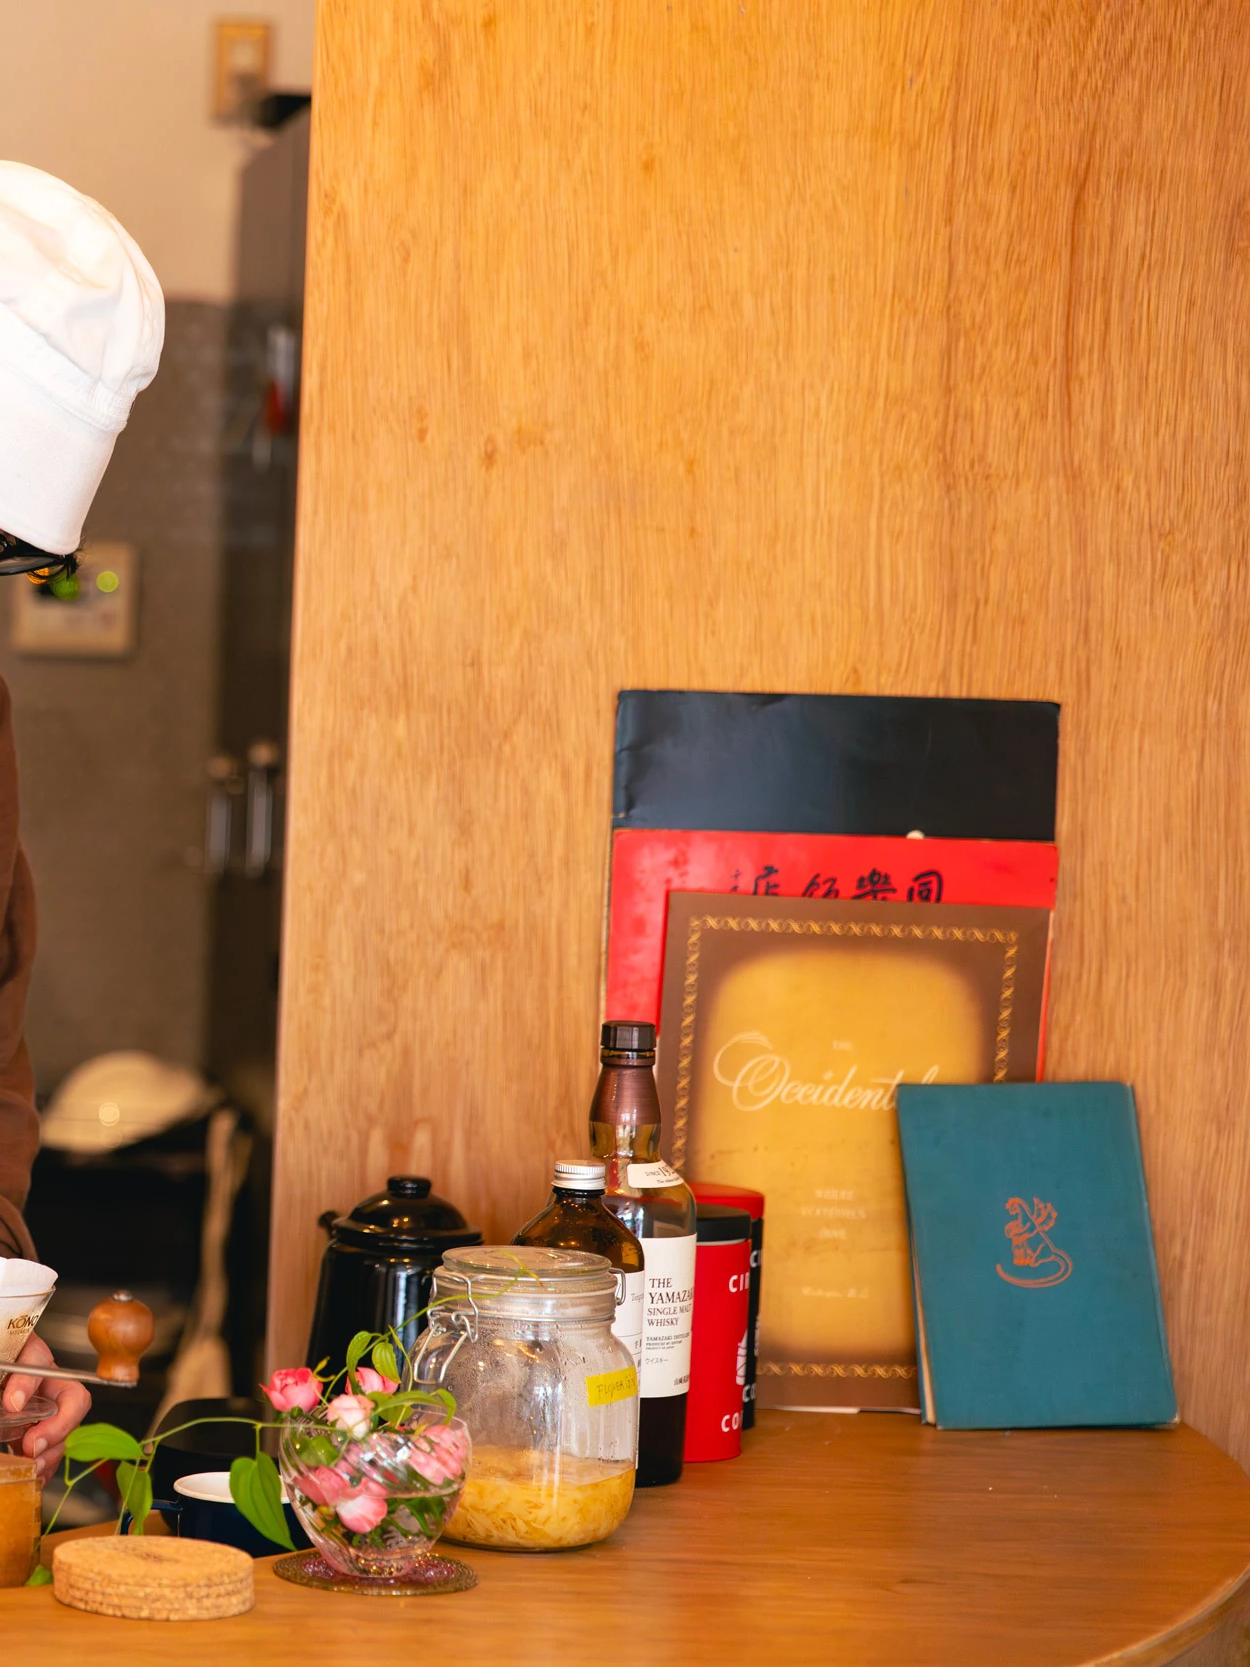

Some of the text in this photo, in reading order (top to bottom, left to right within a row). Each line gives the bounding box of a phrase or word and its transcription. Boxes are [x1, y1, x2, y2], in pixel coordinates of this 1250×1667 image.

[713, 1031, 940, 1112] Occident
[649, 1277, 672, 1289] THE
[647, 1306, 678, 1316] SINGLE
[647, 1317, 679, 1327] WHISKY
